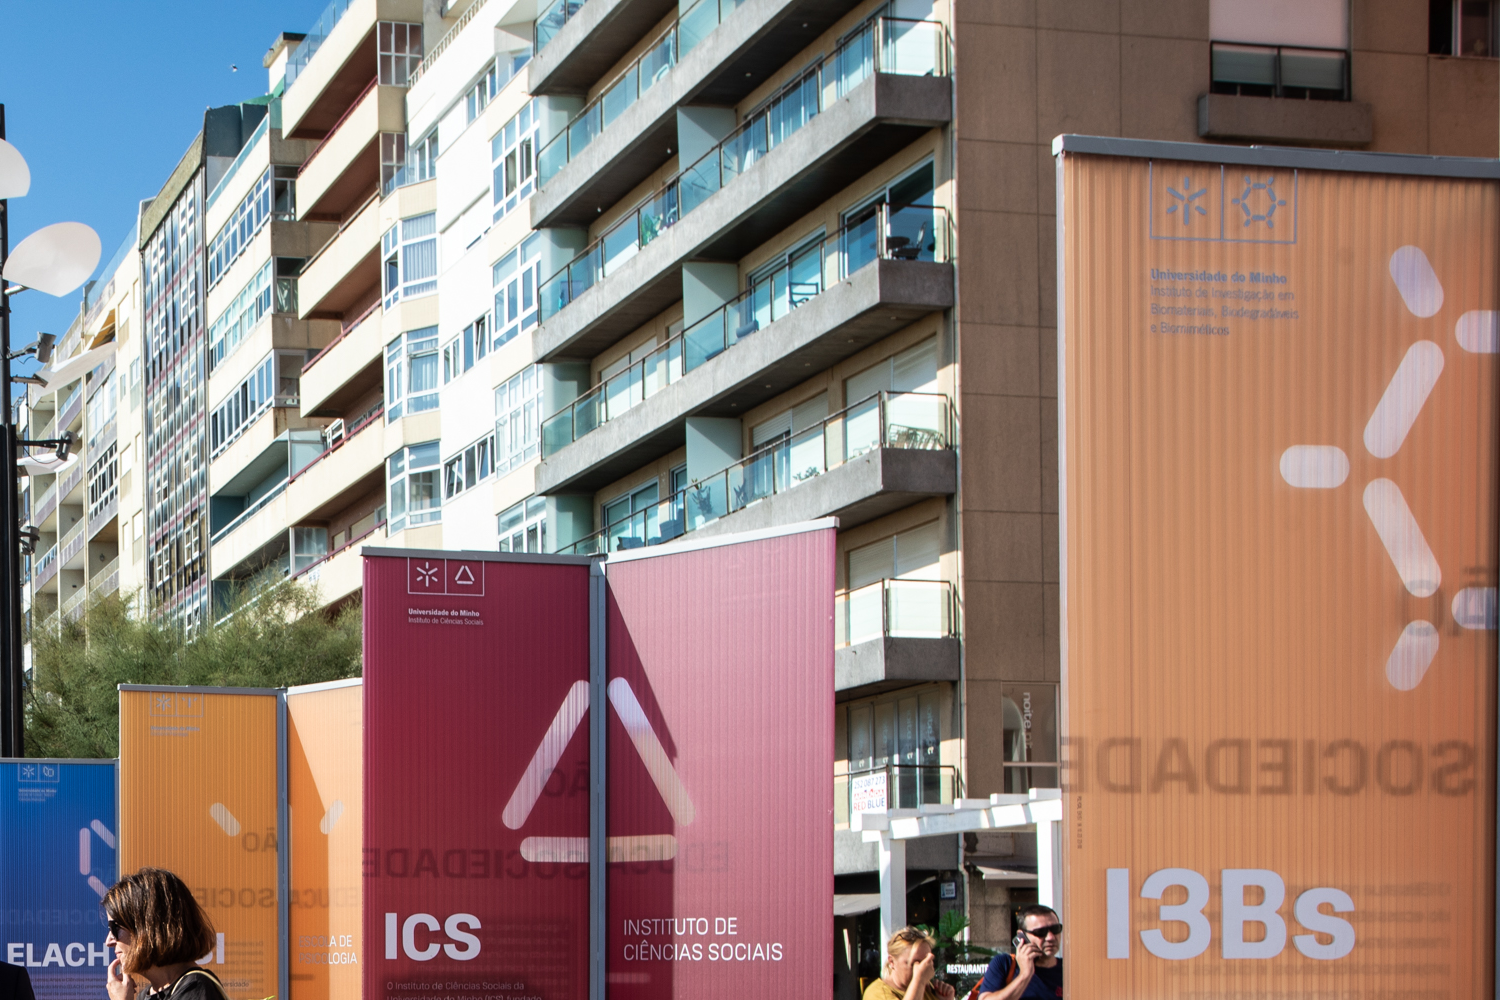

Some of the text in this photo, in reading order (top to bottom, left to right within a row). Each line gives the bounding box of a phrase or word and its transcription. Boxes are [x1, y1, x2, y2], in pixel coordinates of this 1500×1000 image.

[1151, 269, 1287, 284] Universidade do Minho
[1151, 286, 1294, 302] Instituto de Investigação em
[854, 798, 884, 811] RED BLUE
[1106, 867, 1356, 959] I3Bs
[623, 917, 738, 936] INSTITUTO DE
[300, 935, 352, 947] ESCOLA DE
[385, 912, 481, 961] ICS
[7, 942, 109, 967] ELACH
[300, 952, 357, 964] PSICOLOGIA
[623, 940, 783, 961] CIÊNCIAS SOCIAIS
[387, 982, 393, 990] O
[396, 982, 430, 990] Instituto
[432, 982, 443, 990] de
[446, 981, 480, 990] Ciências
[514, 982, 524, 990] da
